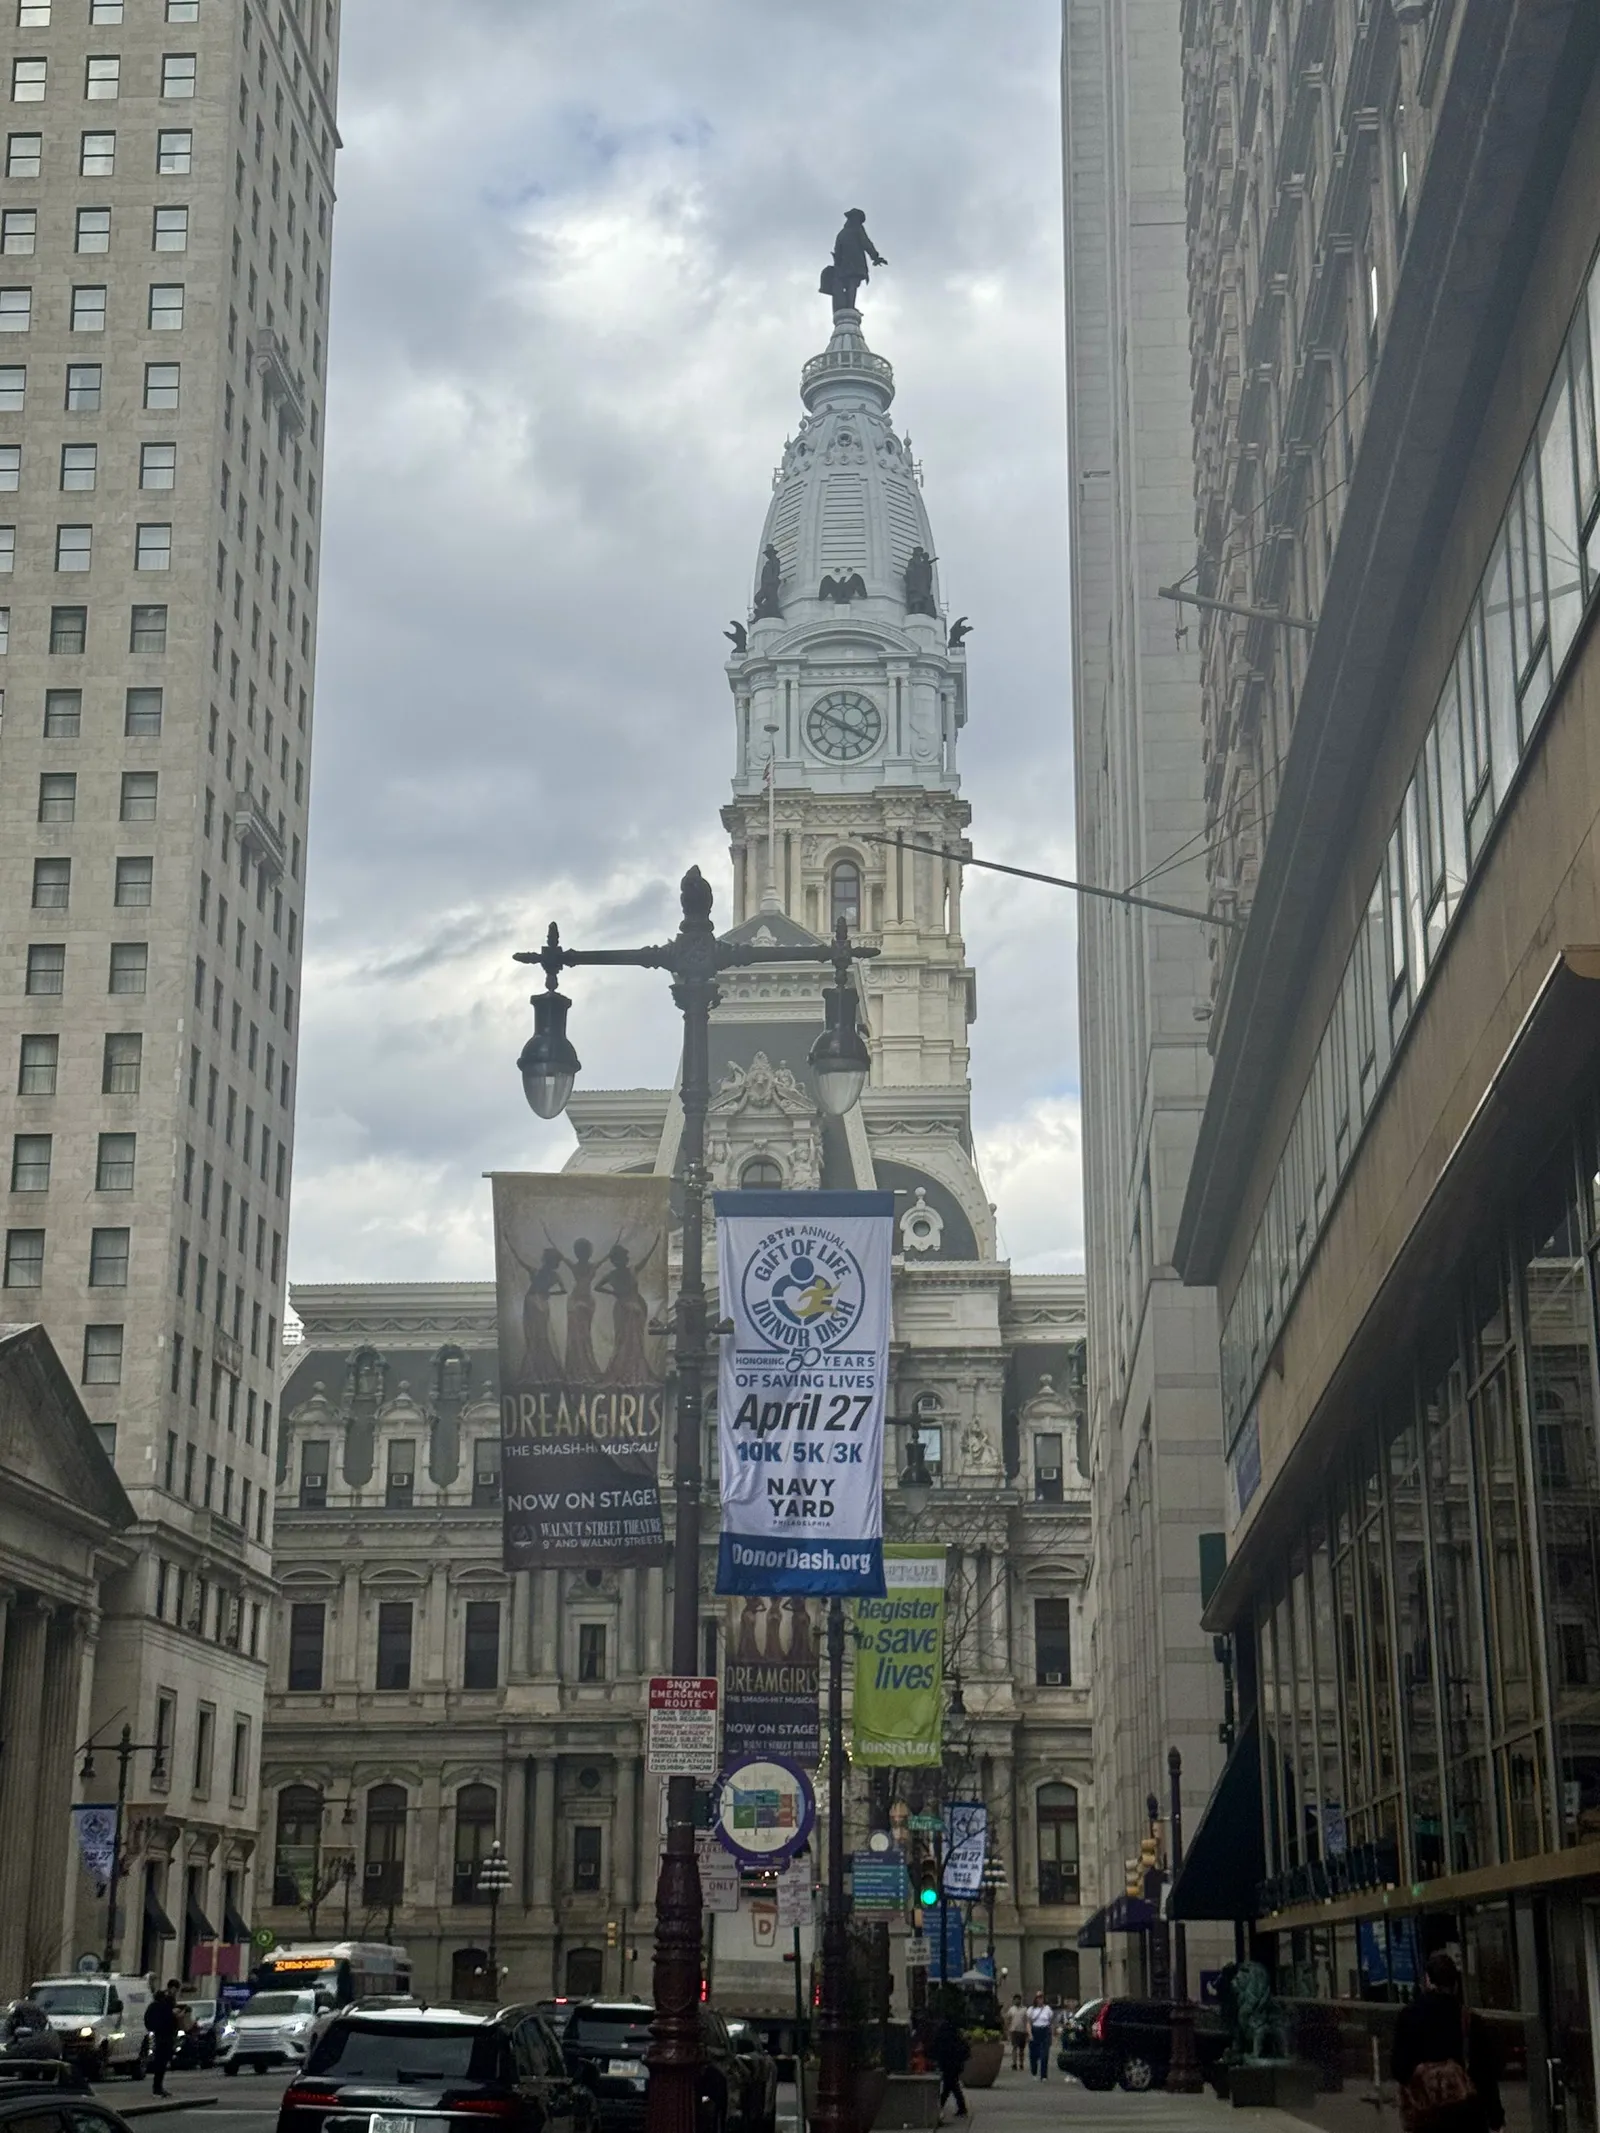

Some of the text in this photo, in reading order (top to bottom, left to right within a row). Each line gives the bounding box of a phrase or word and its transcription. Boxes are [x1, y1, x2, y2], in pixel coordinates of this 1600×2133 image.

[758, 1225, 846, 1251] 28TH ANNUAL
[754, 1238, 852, 1282] GIFT OF LIFE
[752, 1299, 856, 1348] DONOR DASH
[735, 1347, 876, 1373] HONORING 50 YEARS
[735, 1374, 875, 1388] OF SAVING LIVES
[732, 1393, 874, 1438] April 27
[506, 1445, 530, 1457] THE
[533, 1442, 597, 1456] SMASH-H
[767, 1478, 837, 1496] NAVY
[508, 1488, 658, 1512] NOW ON STAGE!
[768, 1499, 835, 1518] YARD
[540, 1520, 582, 1537] WALNUT
[584, 1520, 621, 1537] STREET
[772, 1519, 831, 1527] PHILADELPHIA
[555, 1537, 578, 1548] AND
[581, 1537, 623, 1548] WALNUT
[731, 1543, 871, 1575] DonorDash.org
[857, 1597, 940, 1625] Register
[857, 1627, 938, 1654] to save
[726, 1665, 819, 1693] DREAMGIRLS
[874, 1656, 935, 1690] lives
[666, 1680, 702, 1689] SNOW
[651, 1690, 716, 1699] EMERGENCY
[664, 1699, 702, 1708] ROUTE
[726, 1723, 756, 1734] NOW
[758, 1723, 776, 1734] ON
[709, 1882, 735, 1891] ONLY
[758, 1919, 771, 1935] D
